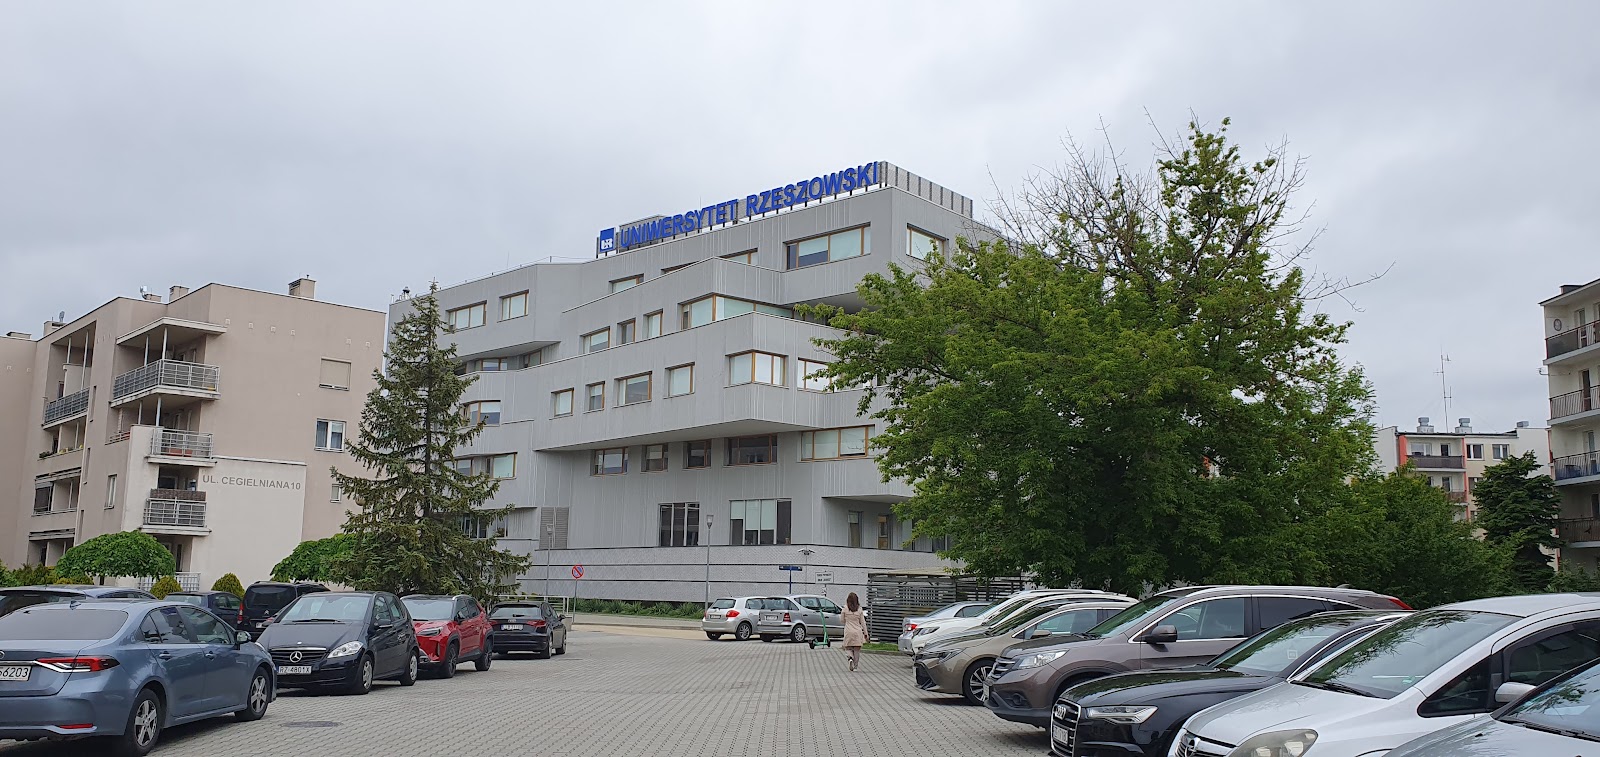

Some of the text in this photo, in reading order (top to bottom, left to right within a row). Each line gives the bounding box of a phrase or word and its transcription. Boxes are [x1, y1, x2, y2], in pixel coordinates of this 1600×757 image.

[620, 161, 878, 248] UNIWERSYTET RZESZOWSKI
[202, 475, 301, 490] UL. CEGIELNIANA 10
